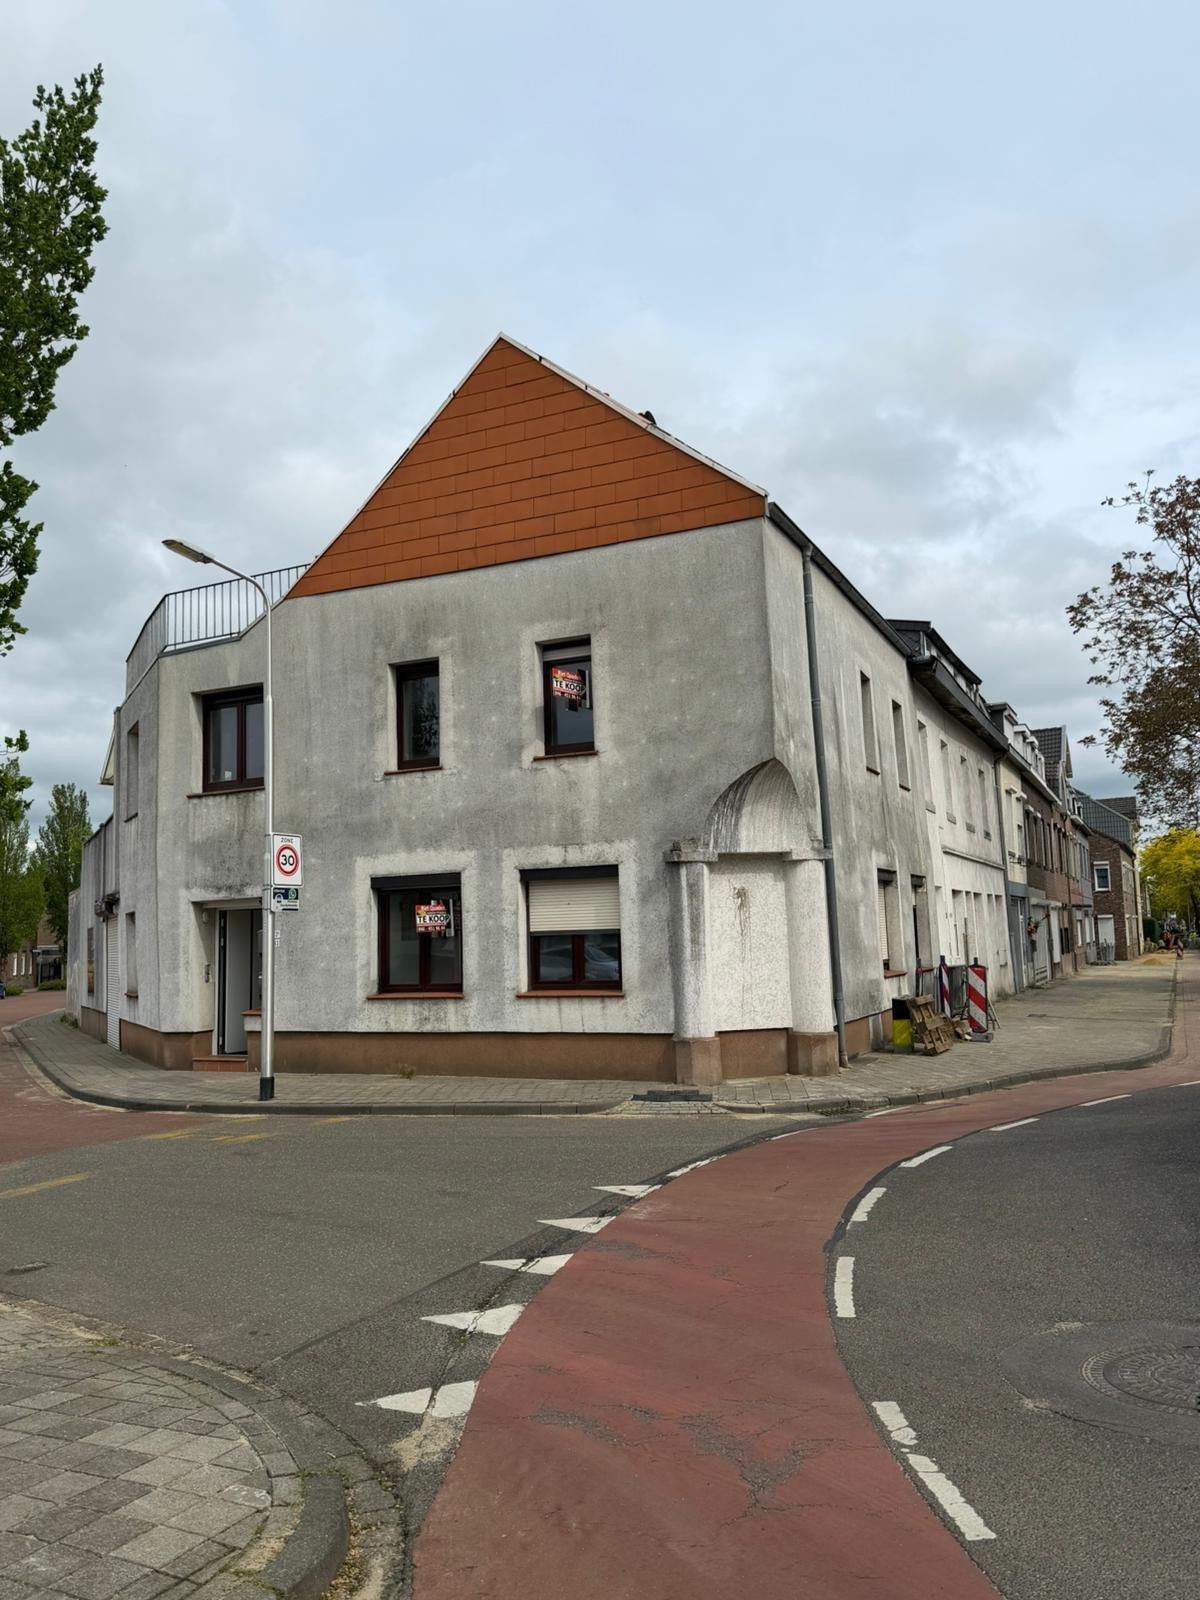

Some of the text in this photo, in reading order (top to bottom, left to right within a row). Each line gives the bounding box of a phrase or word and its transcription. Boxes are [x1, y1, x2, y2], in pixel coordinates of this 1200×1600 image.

[554, 680, 564, 688] TE
[565, 682, 586, 693] KOOP
[281, 854, 295, 866] 30
[417, 915, 450, 923] TE KOOP
